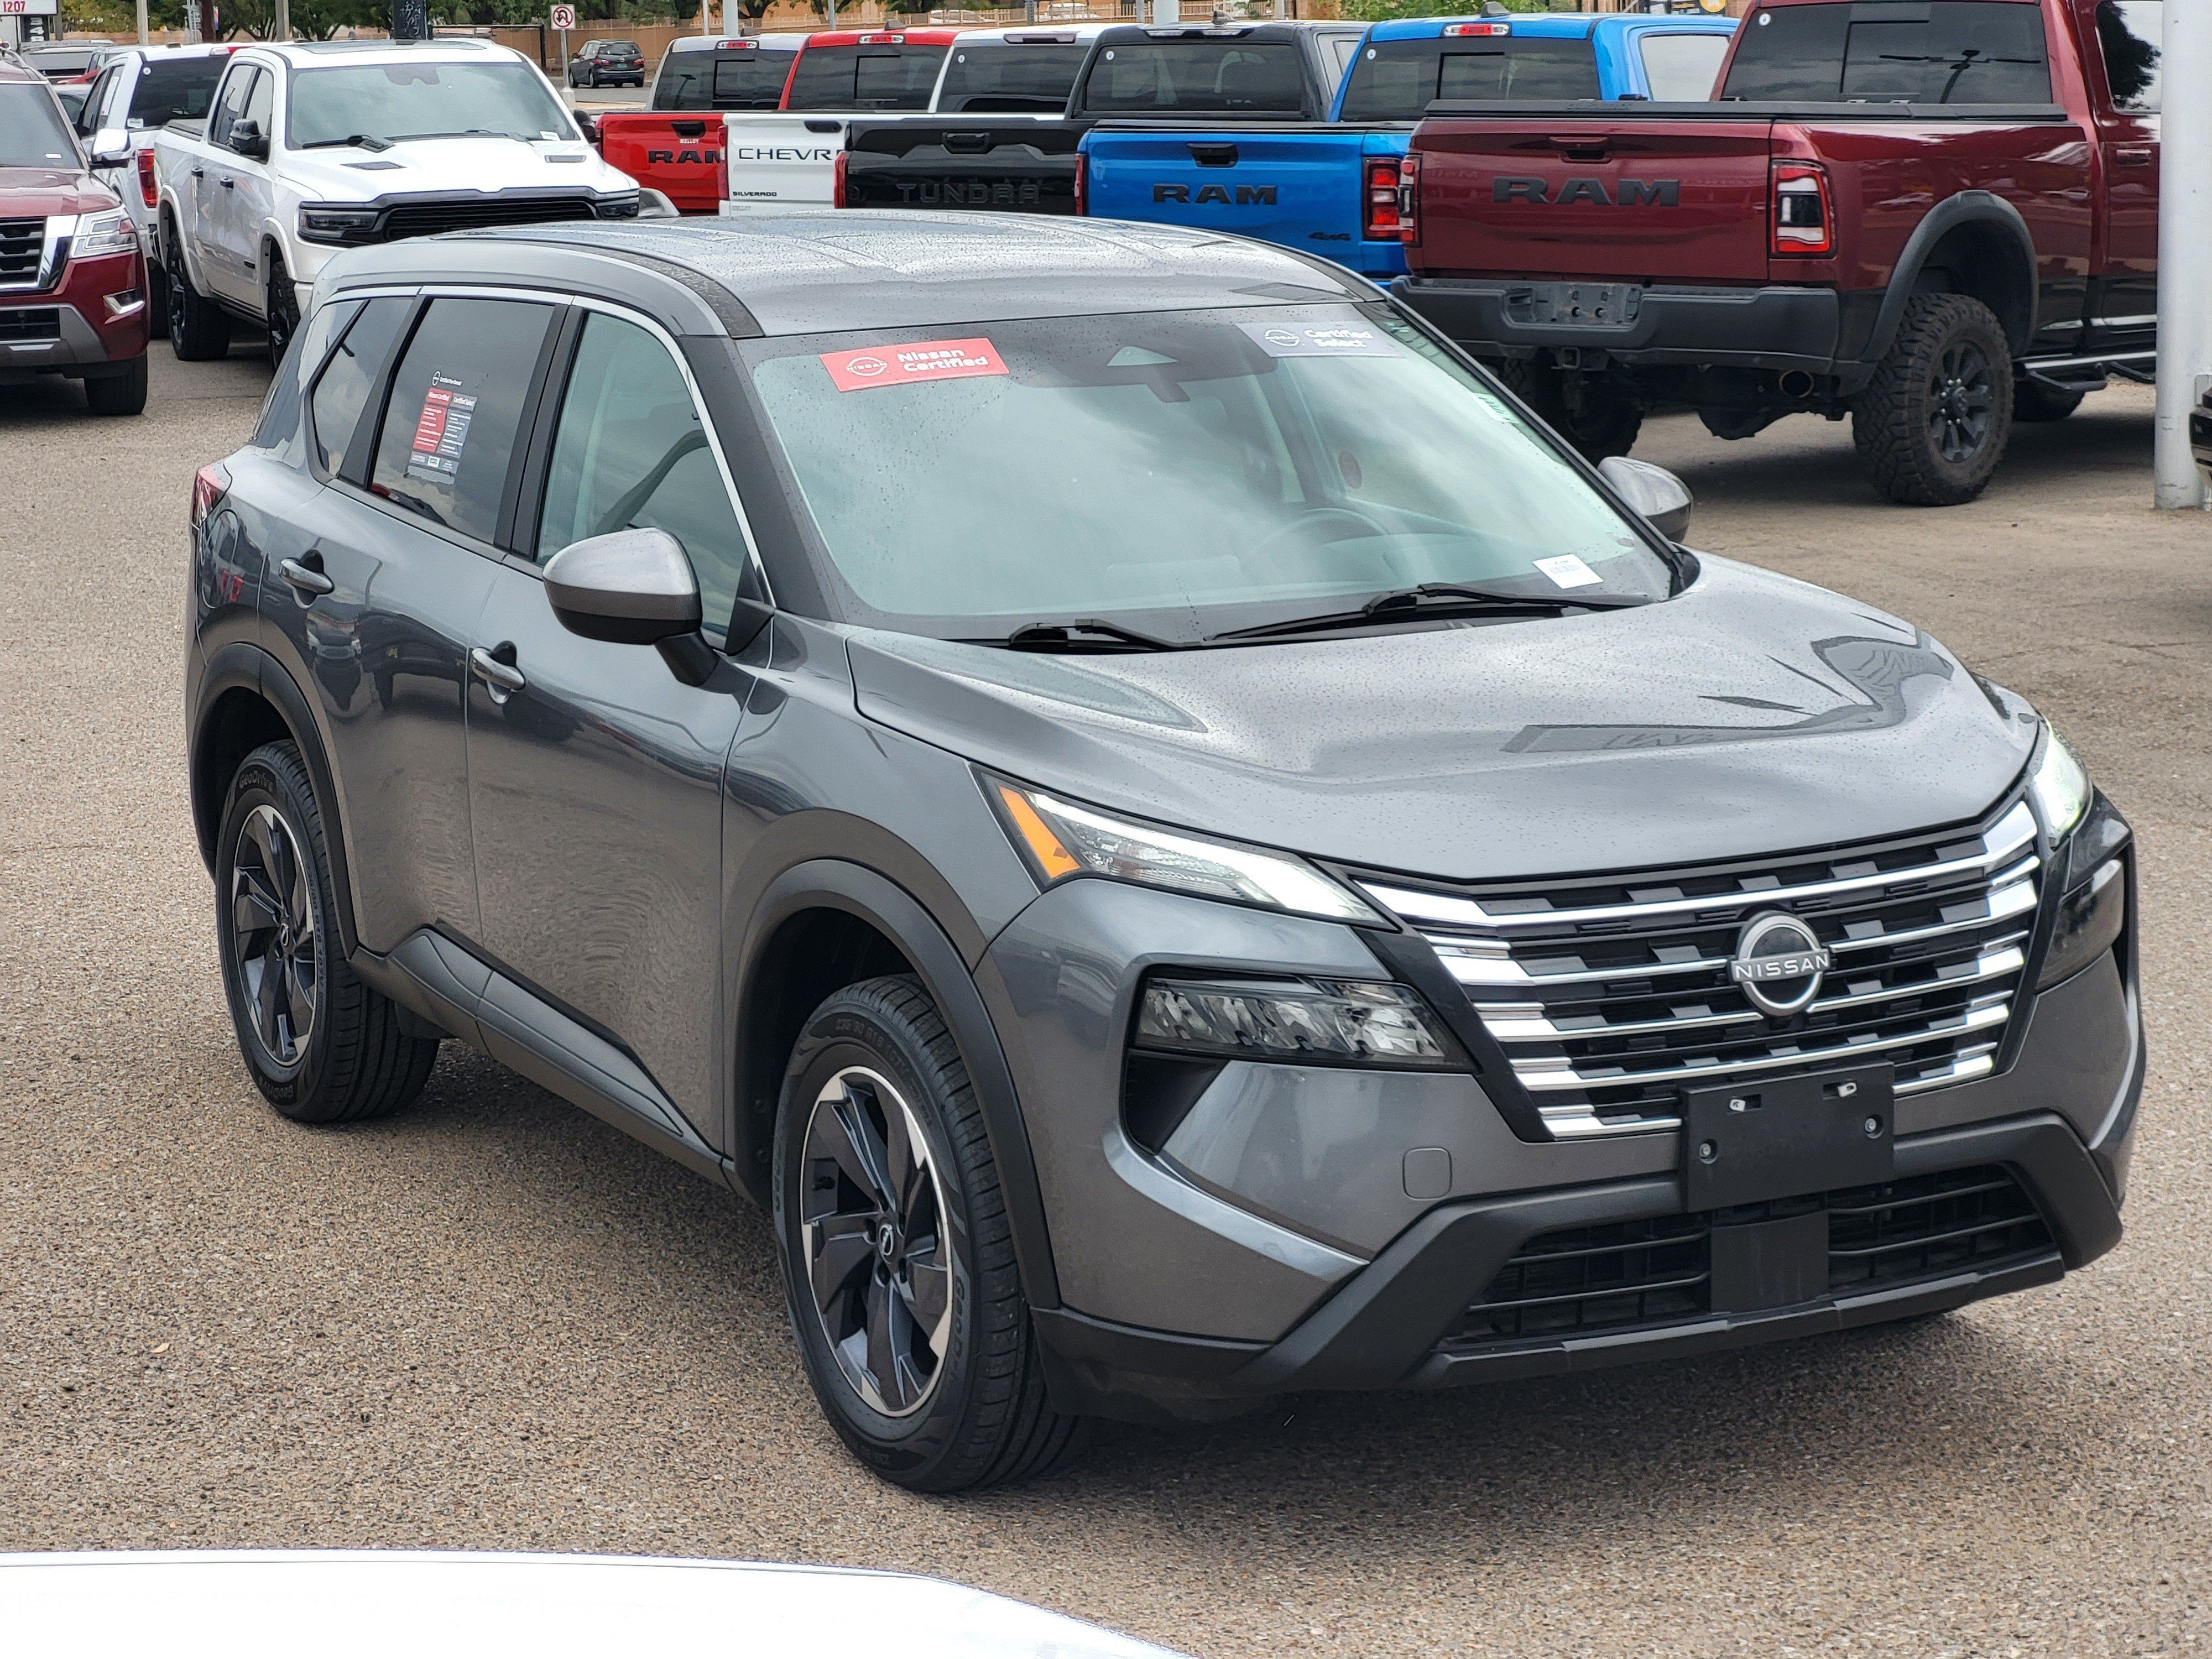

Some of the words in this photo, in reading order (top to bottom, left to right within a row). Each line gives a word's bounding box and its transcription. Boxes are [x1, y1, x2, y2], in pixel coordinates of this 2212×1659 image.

[3, 1, 25, 12] 1207
[738, 148, 844, 160] CHEVR
[895, 183, 1040, 204] TUNDRA
[1152, 184, 1277, 205] RAM
[1494, 175, 1680, 207] RAM
[896, 349, 965, 362] Nissan
[903, 356, 989, 372] Certified
[1735, 952, 1830, 979] NISSAN
